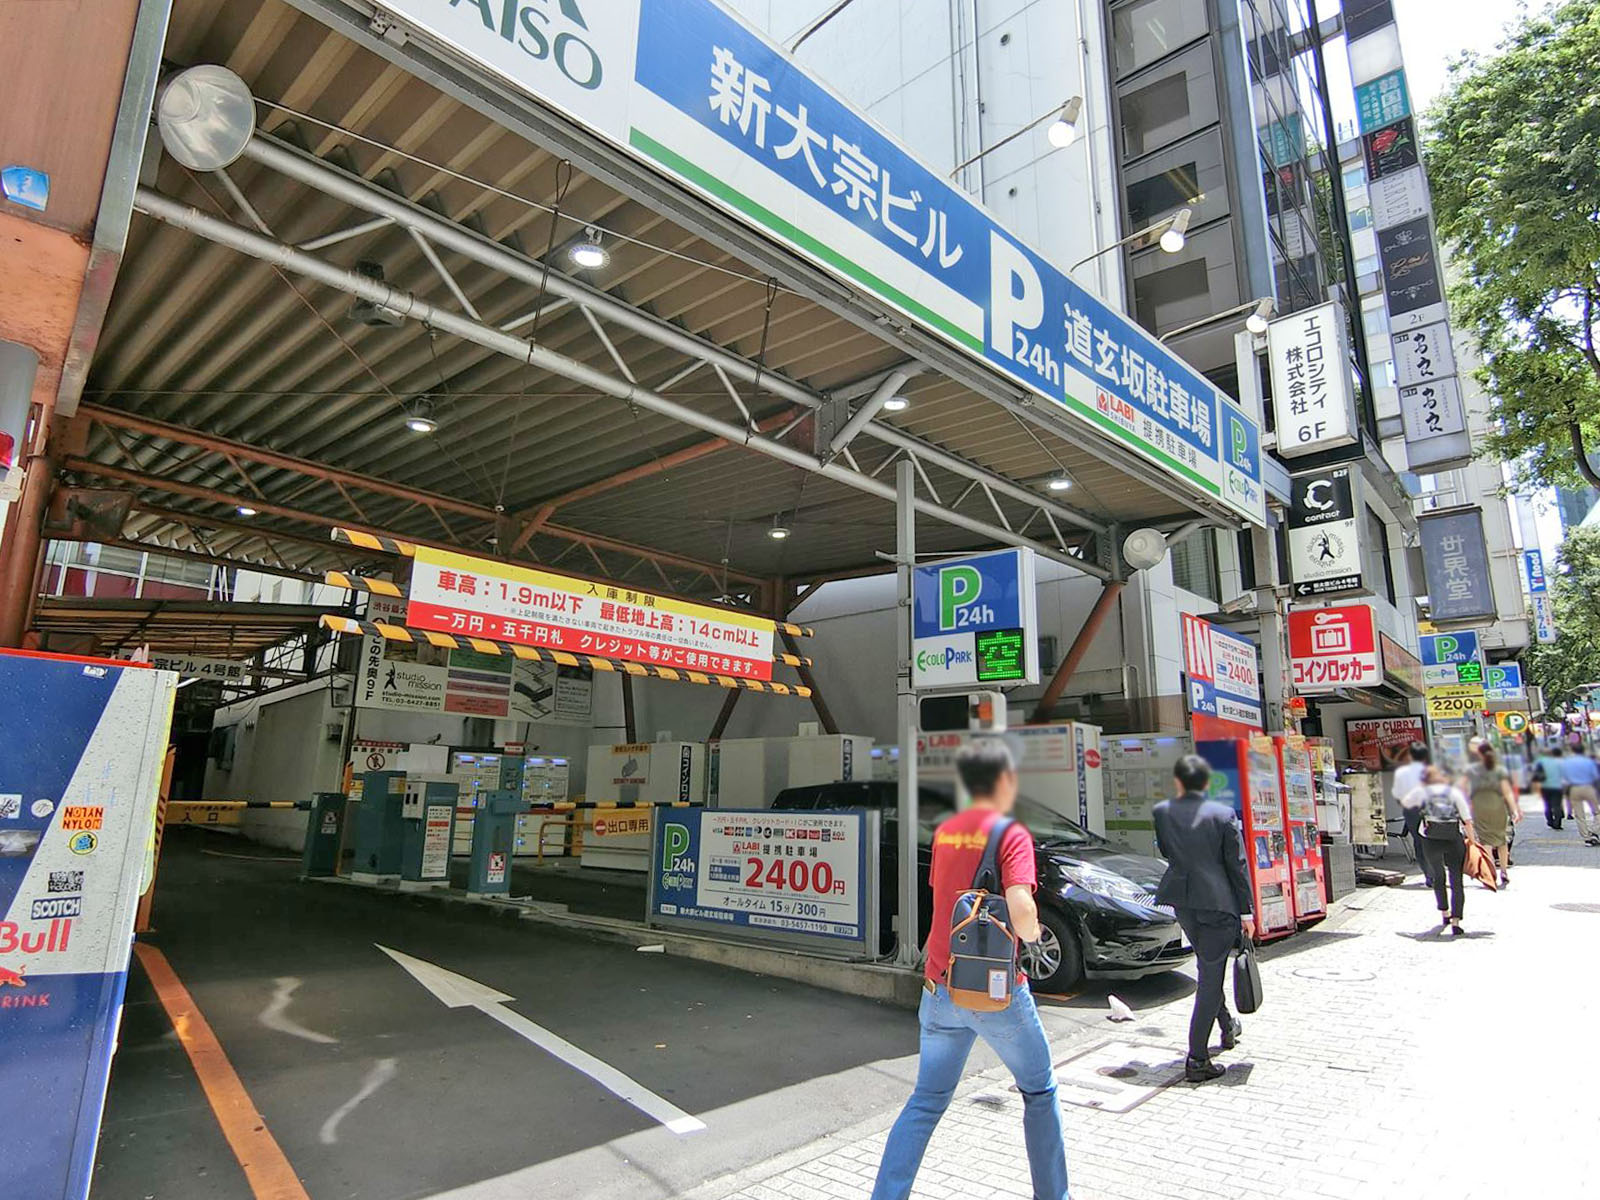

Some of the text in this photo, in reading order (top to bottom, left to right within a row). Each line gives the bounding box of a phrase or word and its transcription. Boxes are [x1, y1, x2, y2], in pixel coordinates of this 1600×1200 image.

[708, 44, 963, 270] 新大宗ビル
[1016, 330, 1059, 386] 24h
[1304, 315, 1327, 408] エコロシティ
[1063, 302, 1212, 448] 道玄坂駐車場
[1286, 346, 1308, 415] 株式会社
[1110, 394, 1134, 423] LABI
[1231, 416, 1247, 466] P
[1298, 420, 1327, 442] 6F
[1305, 510, 1340, 522] contact
[1440, 535, 1473, 600] 世界堂
[587, 583, 656, 607] 入庫制限
[940, 565, 995, 631] P 24h
[433, 612, 758, 676] 一万円・五千円札 クレジット等がご使用できます。
[979, 632, 1021, 679] 空
[1185, 617, 1212, 679] IN
[1434, 635, 1467, 663] P 24h
[397, 670, 426, 682] studio
[1293, 656, 1375, 684] コインロッカー
[1458, 662, 1481, 681] 空
[1487, 668, 1506, 688] P
[408, 680, 442, 691] mission
[1191, 682, 1215, 711] P 24h
[1433, 698, 1482, 711] 2200円
[1355, 722, 1380, 732] SOUP
[1509, 715, 1523, 730] P
[608, 819, 649, 833] 出口専用
[663, 823, 695, 872] P 24h
[742, 842, 759, 850] LABI
[763, 844, 817, 858] 提携駐車場
[745, 857, 845, 895] 2400円
[33, 900, 80, 918] SCOTCH
[723, 896, 766, 911] オールタイム
